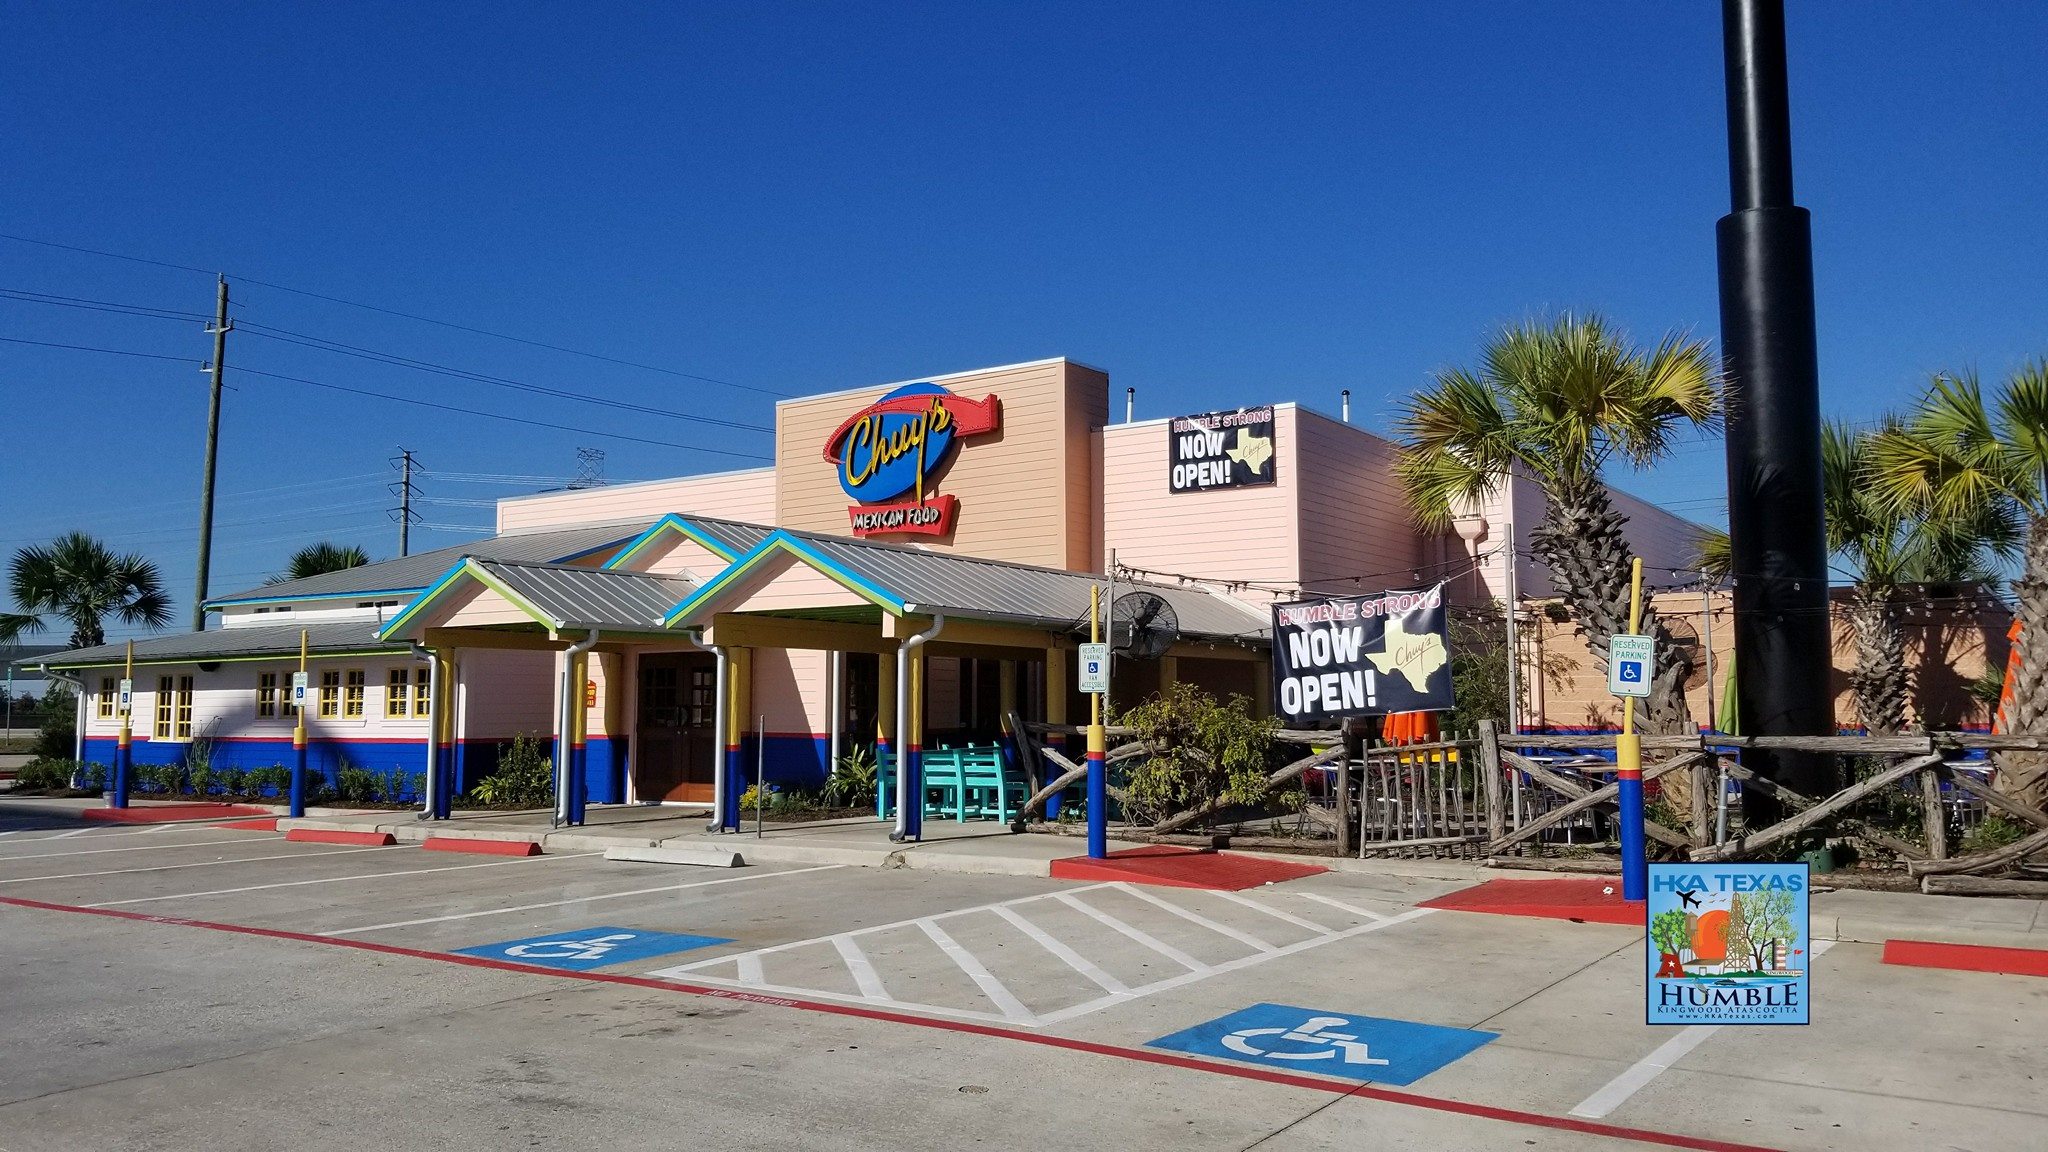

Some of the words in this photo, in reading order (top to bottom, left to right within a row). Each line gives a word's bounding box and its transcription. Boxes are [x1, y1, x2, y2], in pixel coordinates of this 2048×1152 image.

[1173, 415, 1221, 433] HUMBLE
[1222, 409, 1272, 428] STRONG
[845, 397, 950, 506] Chuy's
[1179, 431, 1225, 460] NOW
[1172, 459, 1231, 489] OPEN!
[852, 511, 904, 530] MEXICAN
[906, 506, 940, 526] FOOD
[1279, 602, 1357, 627] HUMBLE
[1360, 592, 1441, 619] STRONG
[1288, 626, 1362, 669] NOW
[1395, 636, 1432, 674] Chuy's
[1614, 640, 1650, 650] RESERVED
[1615, 650, 1647, 660] PARKING
[1280, 669, 1376, 715] OPEN!
